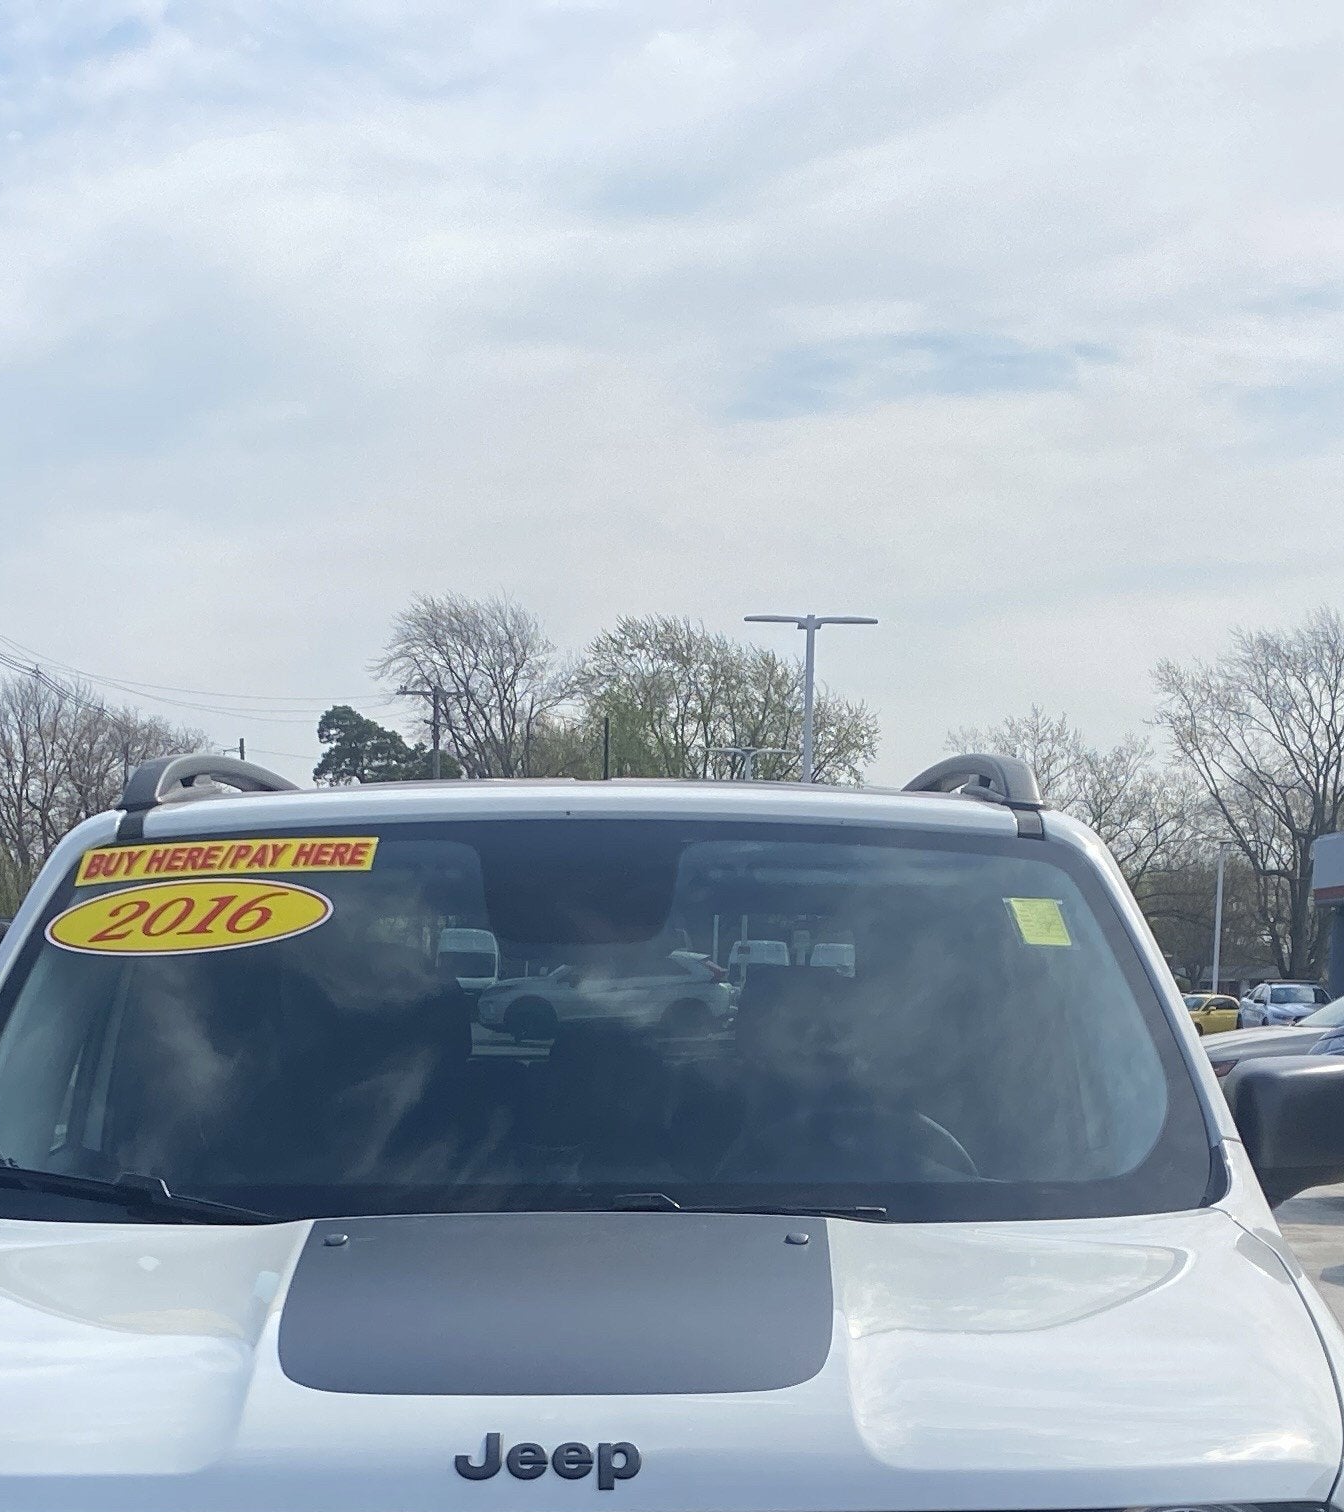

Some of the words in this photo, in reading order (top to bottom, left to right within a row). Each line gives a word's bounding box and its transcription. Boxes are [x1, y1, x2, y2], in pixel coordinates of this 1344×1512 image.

[82, 850, 147, 880] BUY
[144, 842, 288, 874] HERE/PAY
[291, 841, 371, 868] HERE
[88, 891, 290, 944] 2016
[454, 1432, 643, 1491] Jeep
